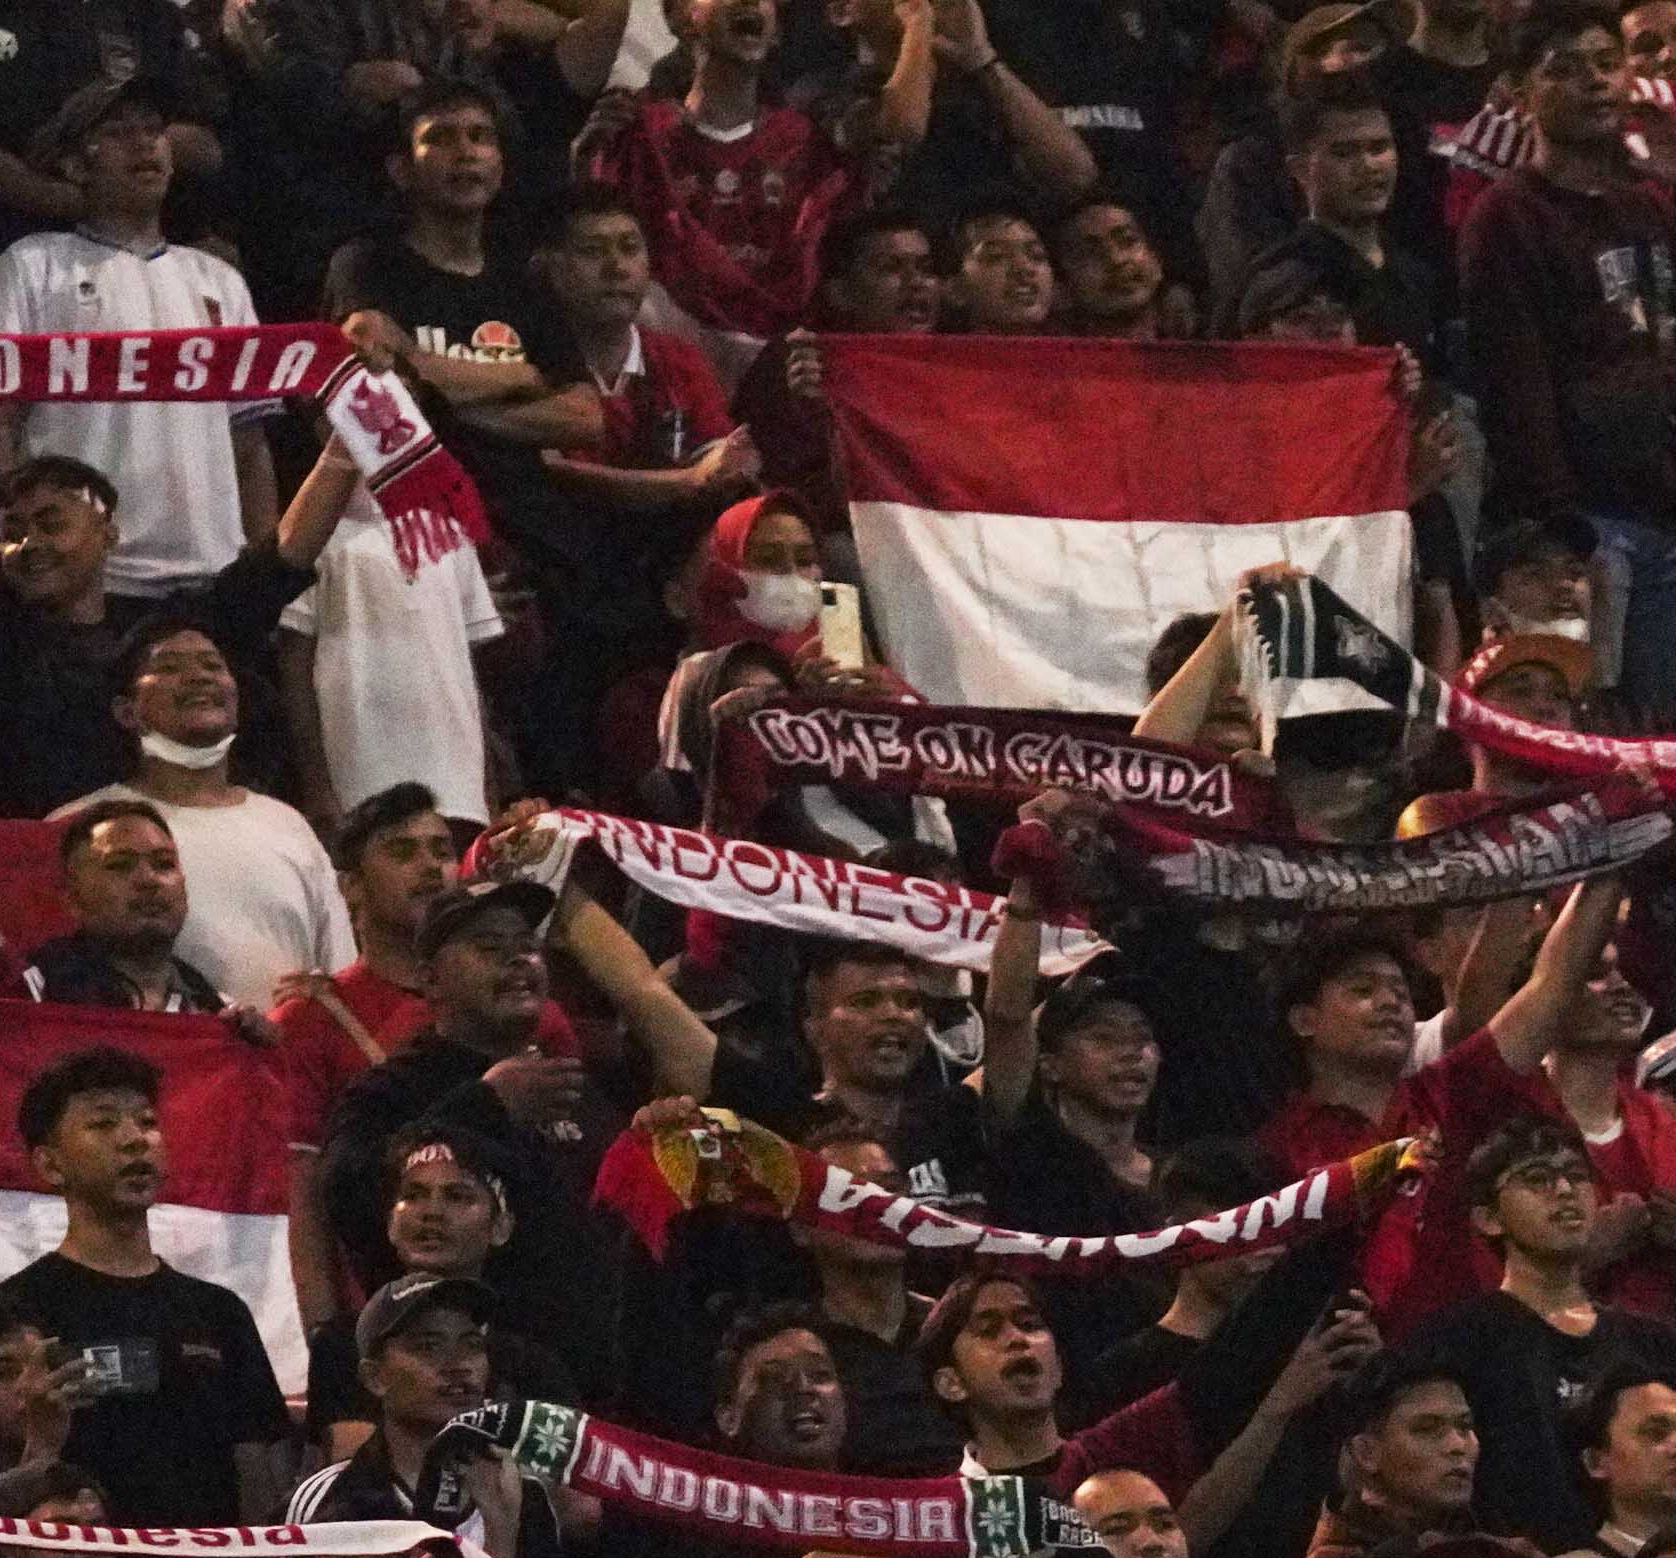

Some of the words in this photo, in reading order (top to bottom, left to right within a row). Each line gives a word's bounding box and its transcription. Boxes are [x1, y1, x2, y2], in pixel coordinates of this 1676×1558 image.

[748, 706, 912, 780] COME
[913, 723, 997, 779] ON
[1004, 732, 1235, 818] GARUDA
[581, 1432, 961, 1543] INDONESIA
